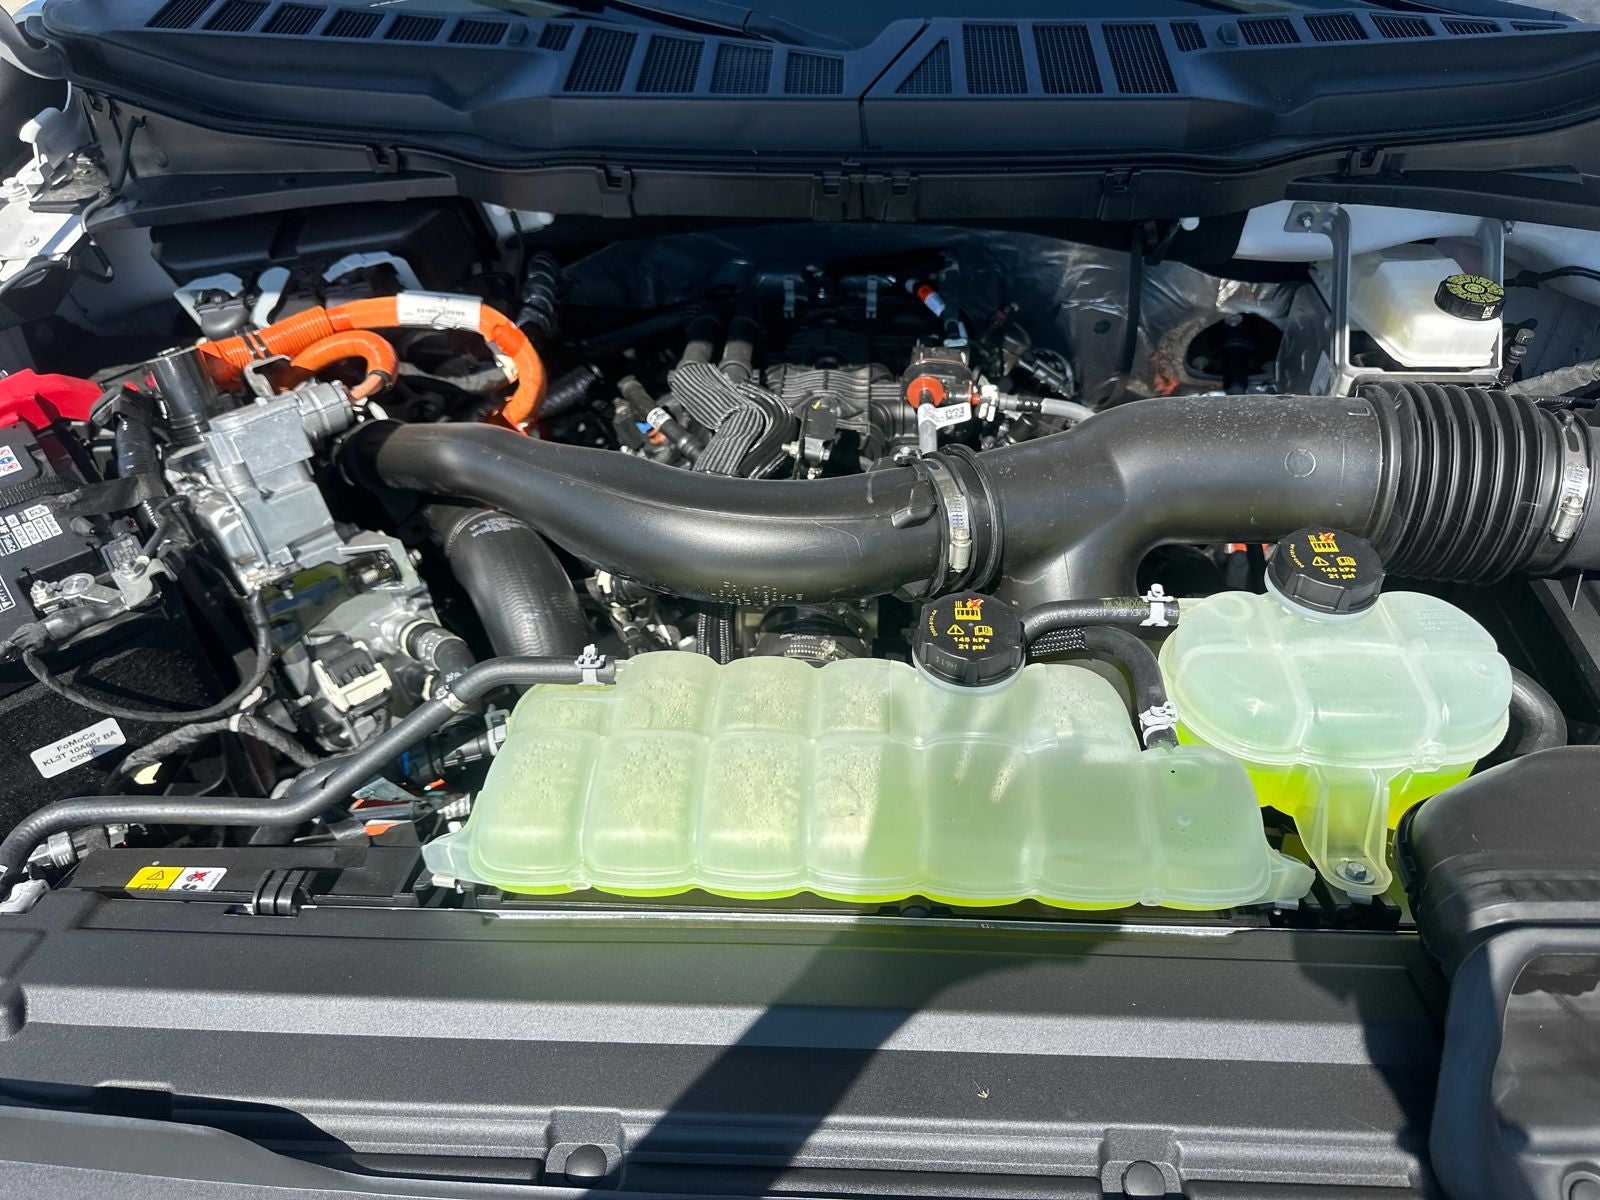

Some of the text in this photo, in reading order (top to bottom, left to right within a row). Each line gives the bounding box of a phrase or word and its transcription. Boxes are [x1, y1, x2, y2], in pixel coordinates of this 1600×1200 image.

[43, 754, 66, 766] KL3T
[103, 730, 117, 740] BA
[57, 732, 96, 752] FoMoCo
